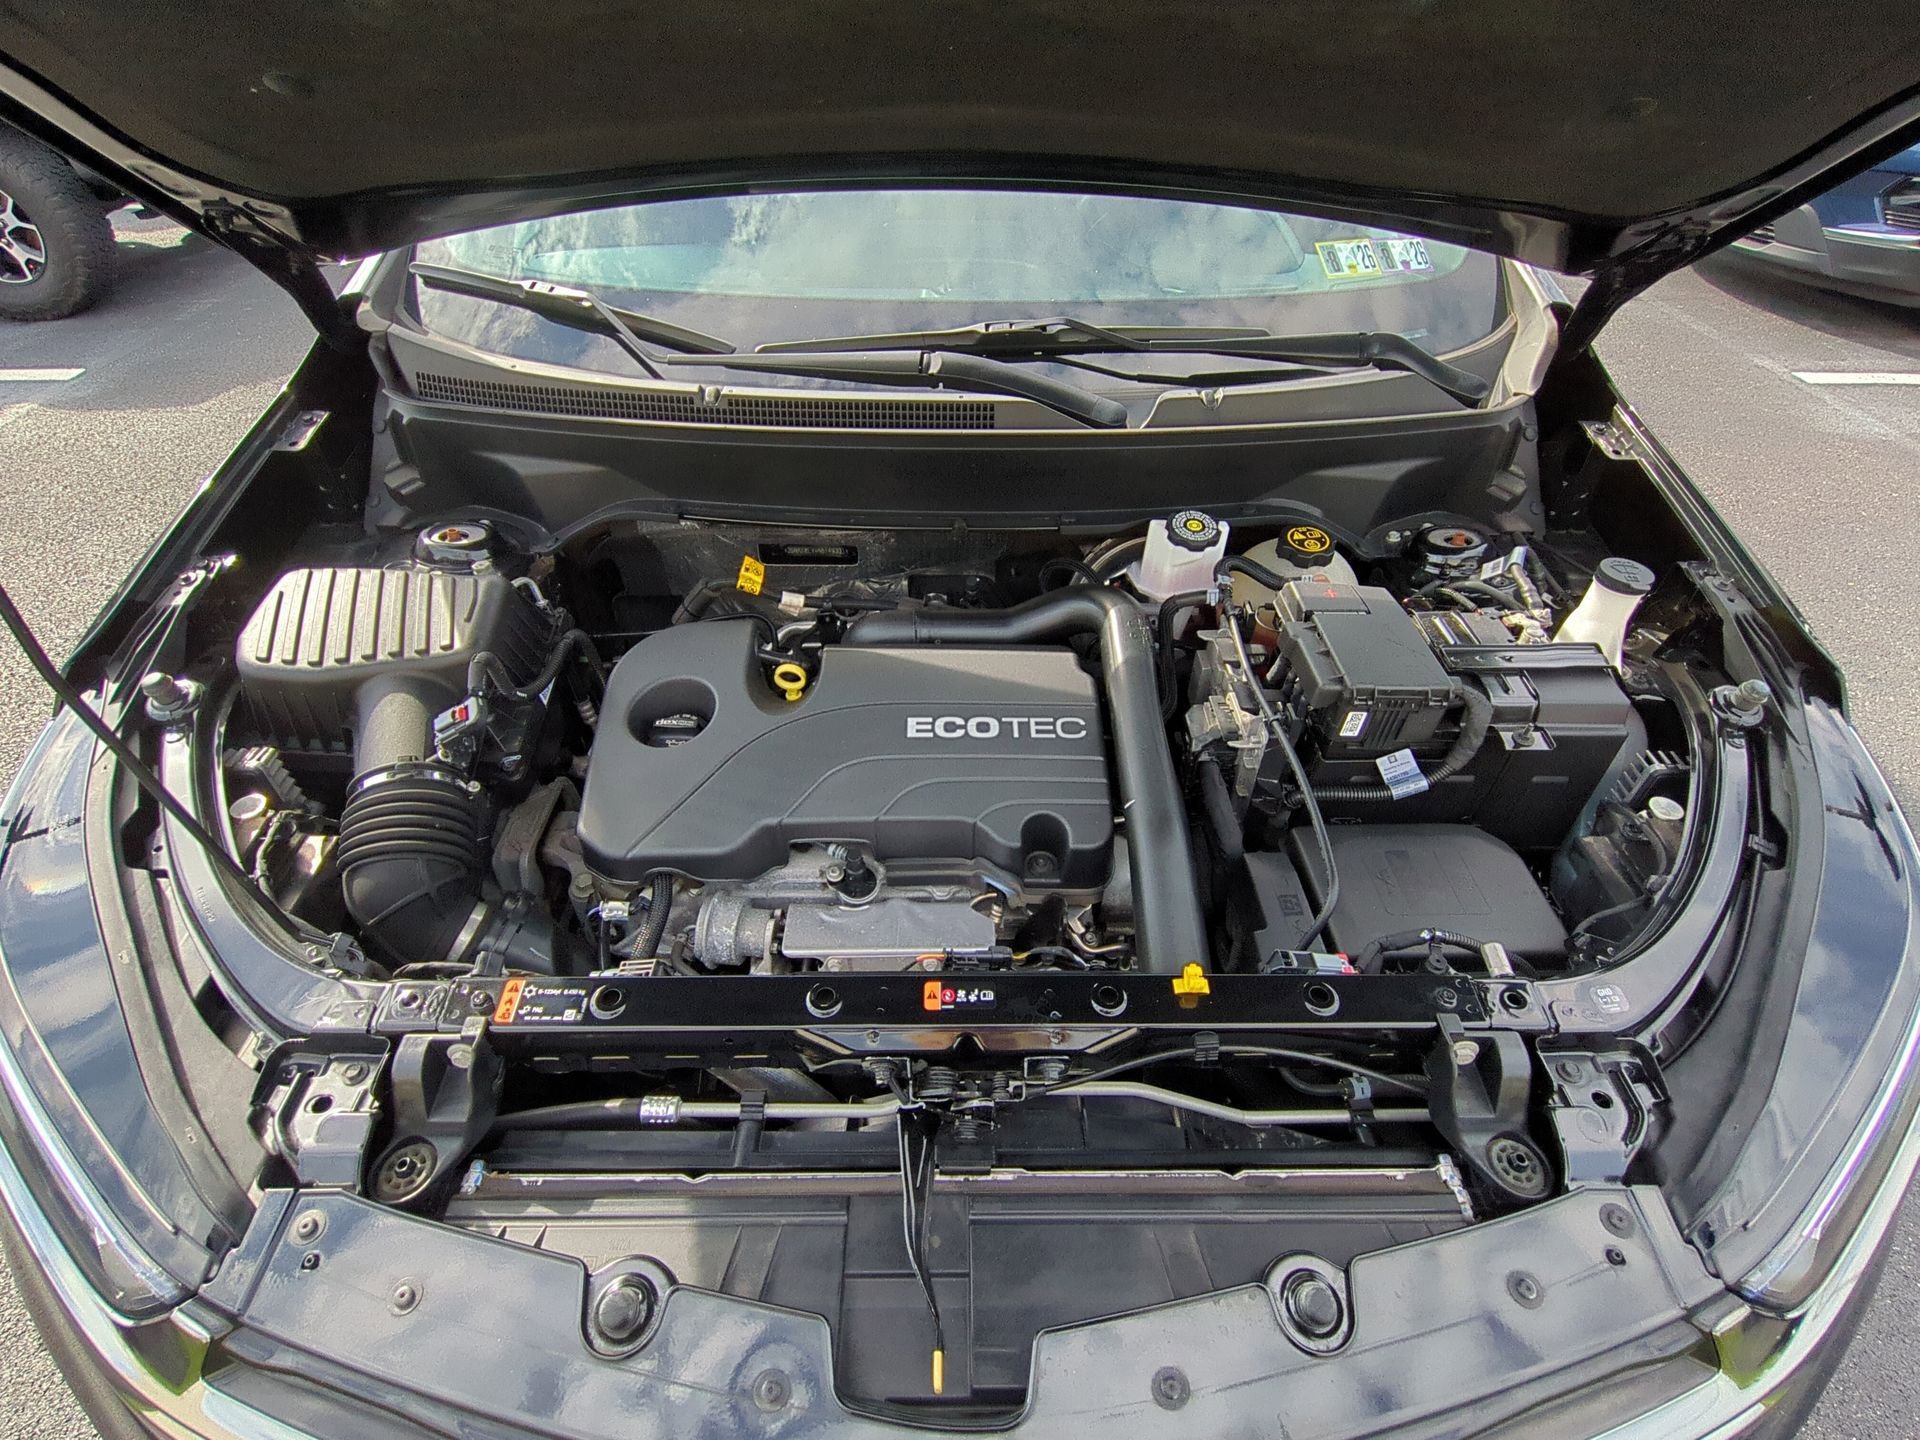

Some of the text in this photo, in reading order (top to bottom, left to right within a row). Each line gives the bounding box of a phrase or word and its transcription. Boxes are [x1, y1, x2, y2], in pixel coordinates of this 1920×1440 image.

[1327, 244, 1376, 273] 8 26
[1381, 240, 1429, 269] 8 26
[906, 716, 1087, 739] ECOTEC
